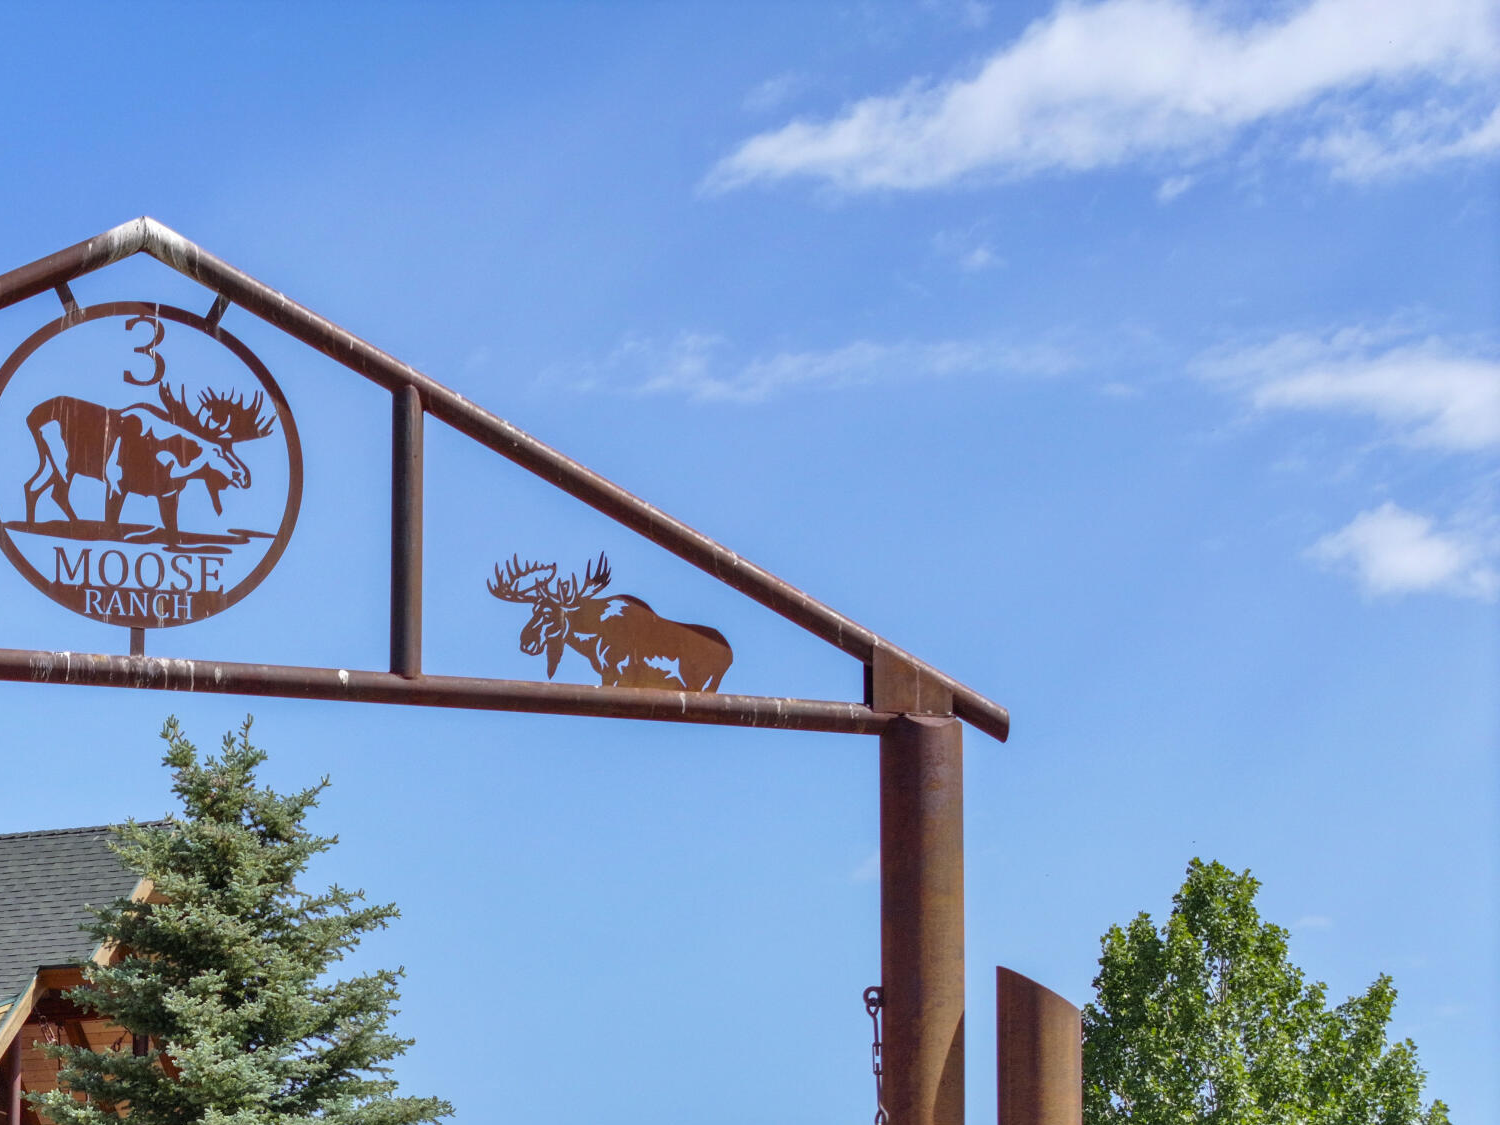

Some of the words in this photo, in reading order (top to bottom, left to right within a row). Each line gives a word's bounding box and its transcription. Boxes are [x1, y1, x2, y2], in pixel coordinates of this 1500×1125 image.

[123, 315, 166, 386] 3
[53, 547, 224, 593] MOOSE
[84, 589, 193, 620] RANCH
